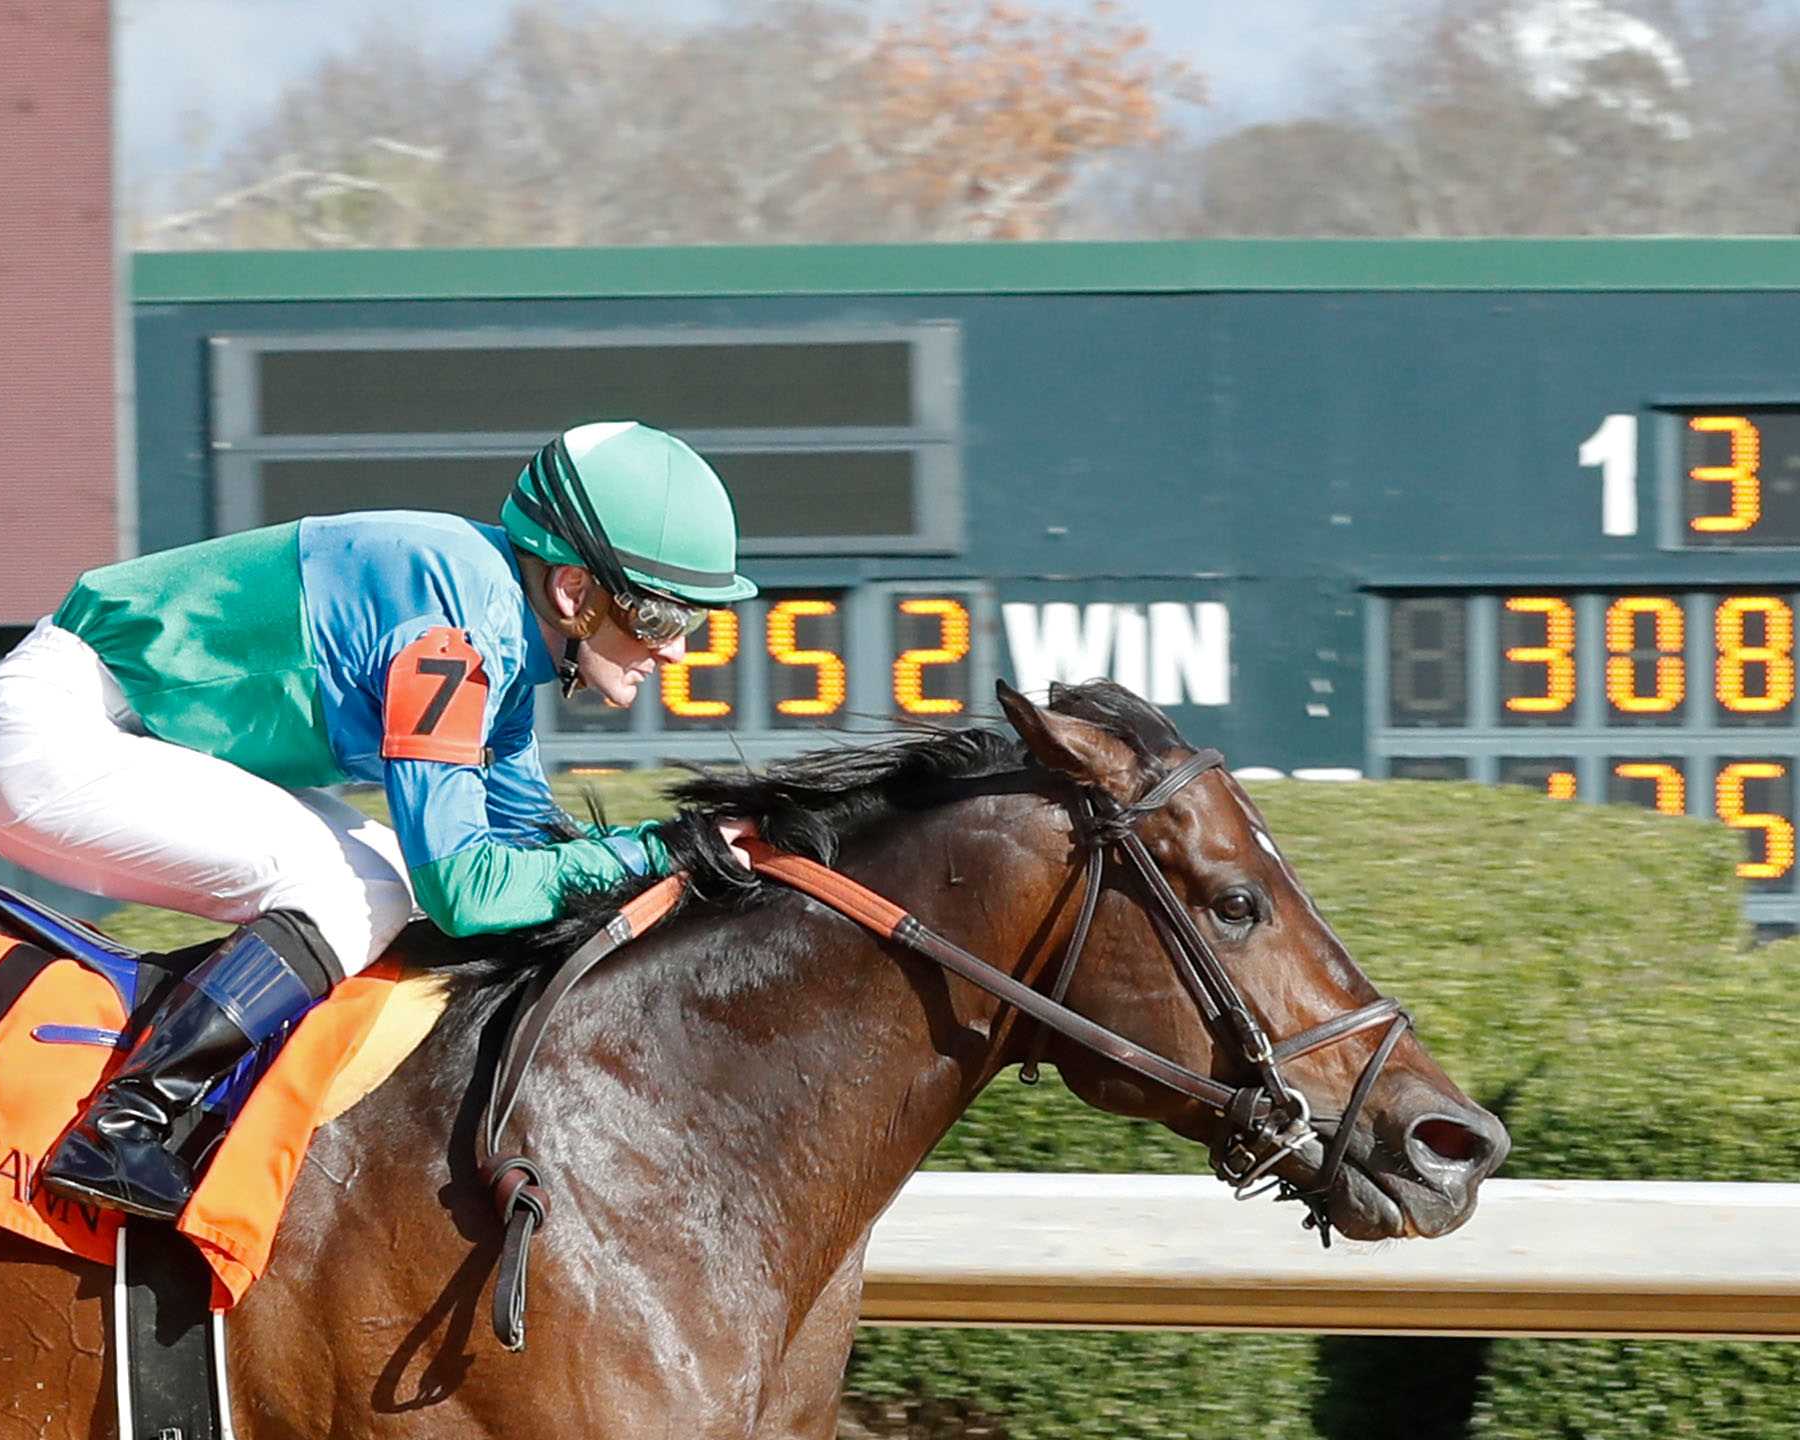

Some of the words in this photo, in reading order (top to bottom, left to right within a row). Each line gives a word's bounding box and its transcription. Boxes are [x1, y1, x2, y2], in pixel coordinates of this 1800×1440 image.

[1578, 414, 1639, 536] 1
[1688, 415, 1761, 533] 3
[411, 657, 467, 736] 7
[1001, 602, 1230, 706] WIN
[1505, 596, 1795, 713] 308
